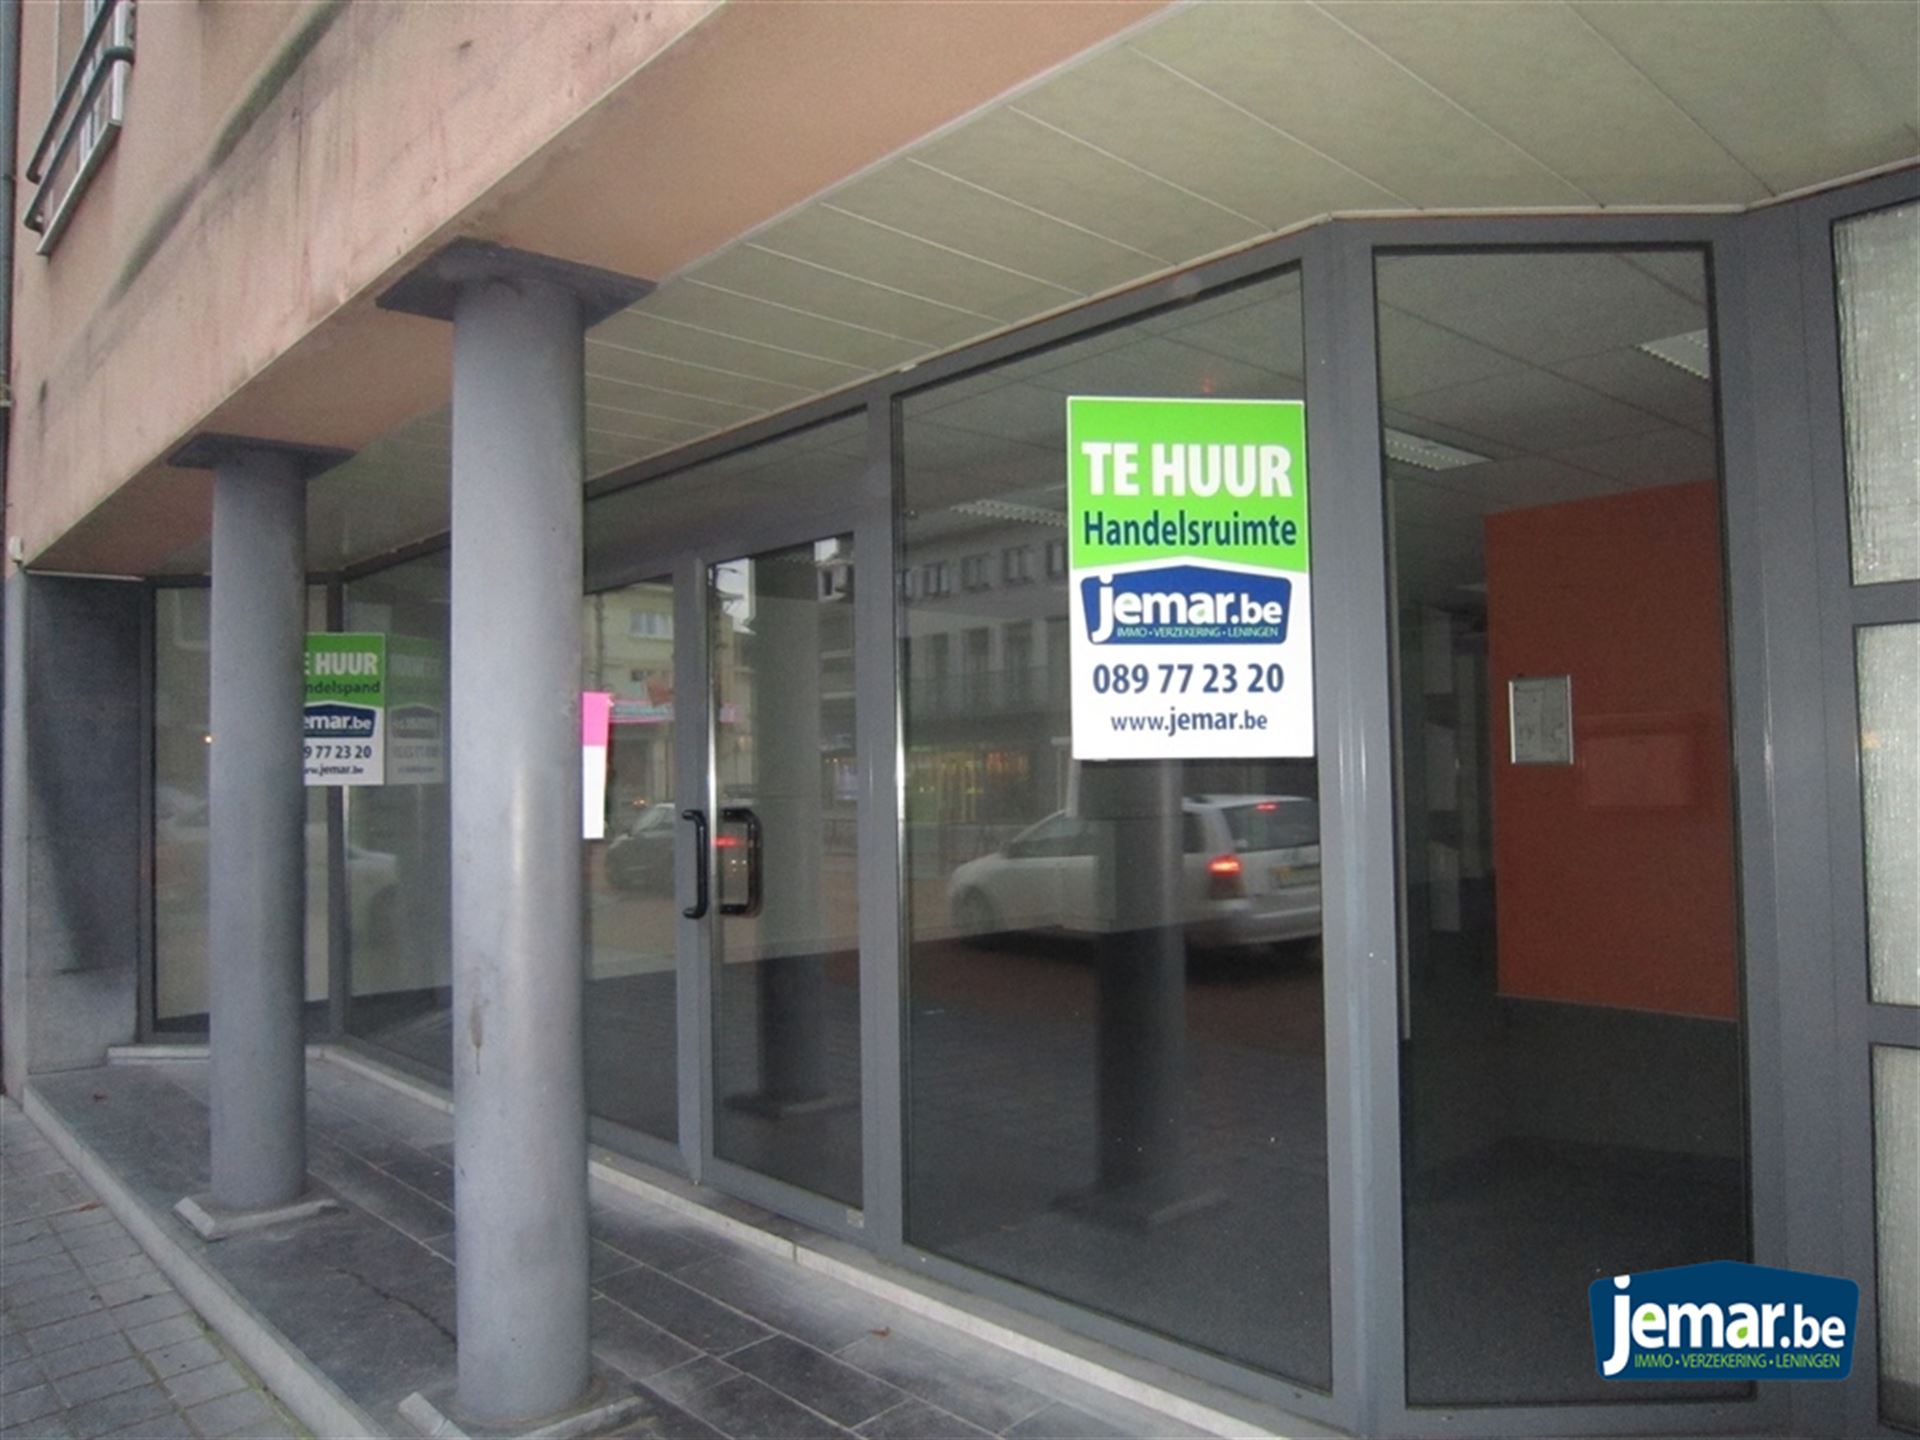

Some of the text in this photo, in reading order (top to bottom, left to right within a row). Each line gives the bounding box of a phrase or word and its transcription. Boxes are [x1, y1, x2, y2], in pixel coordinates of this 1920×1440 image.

[1082, 441, 1293, 498] TE HUUR
[1083, 510, 1297, 546] Handelsruimte
[1092, 574, 1283, 643] jemar.be
[1117, 627, 1279, 638] IMMO VERZEKERING LENINGEN
[315, 652, 378, 676] HUUR
[1092, 663, 1285, 694] 089 77 23 20
[304, 681, 380, 696] ndelspand
[1110, 706, 1268, 736] www.jemar.be
[315, 745, 332, 759] 77
[335, 745, 351, 759] 23
[354, 745, 372, 759] 20
